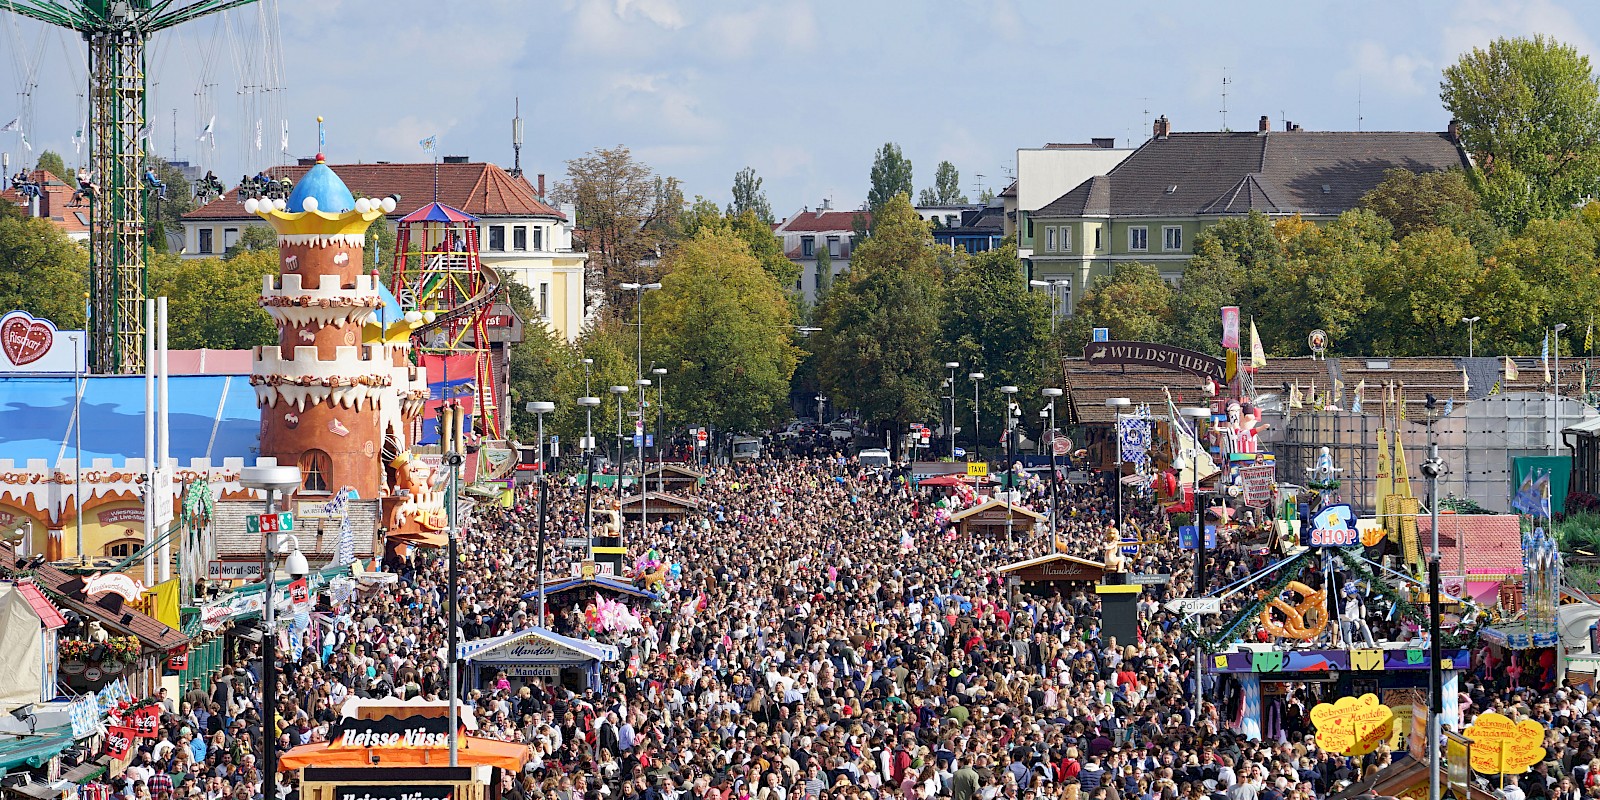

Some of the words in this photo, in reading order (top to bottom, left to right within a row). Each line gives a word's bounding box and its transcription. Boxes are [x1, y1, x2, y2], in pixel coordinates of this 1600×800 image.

[1110, 346, 1227, 379] WILDSTUBEN
[971, 466, 984, 475] TAXI
[1311, 529, 1357, 545] SHOP
[210, 566, 219, 575] 26
[221, 566, 261, 575] Notruf-SOS
[1040, 563, 1082, 575] Mandelfee
[1181, 600, 1215, 610] Polizei
[511, 646, 555, 656] Mandeln
[1317, 704, 1360, 718] Gebrannte
[1348, 709, 1386, 722] Mandeln
[1477, 719, 1513, 729] Gebrannte
[341, 728, 400, 747] Heisse
